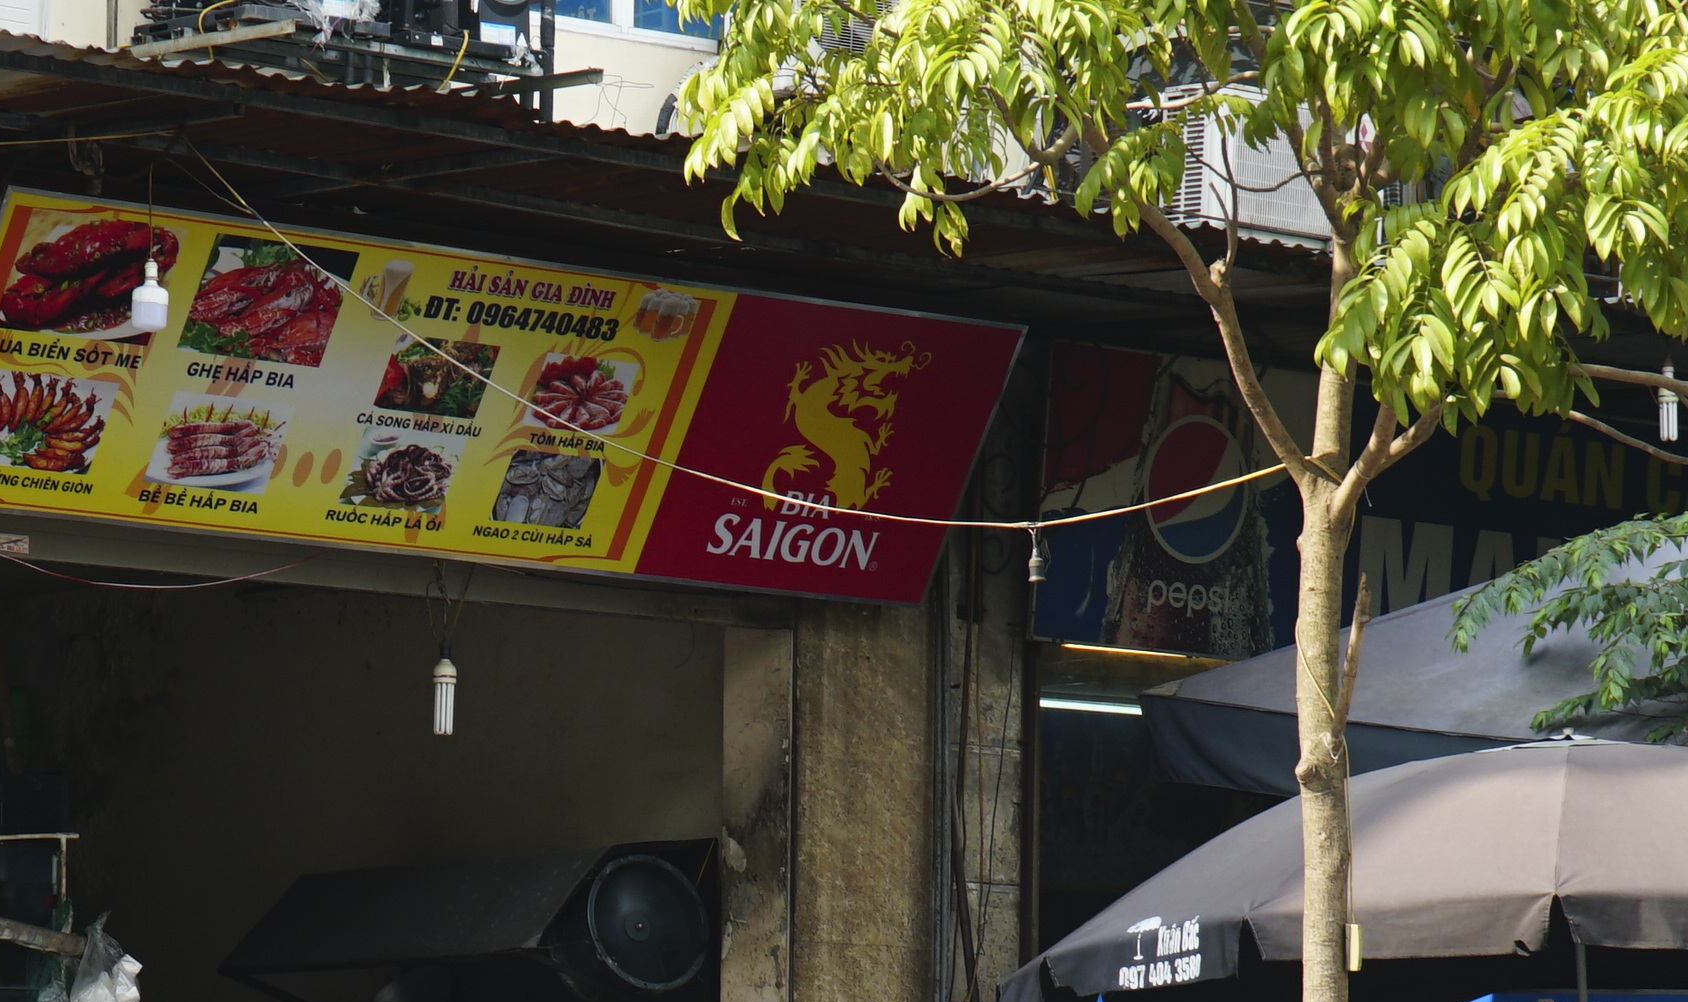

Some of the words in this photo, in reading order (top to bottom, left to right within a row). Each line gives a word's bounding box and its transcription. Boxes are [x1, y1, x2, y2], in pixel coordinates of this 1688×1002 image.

[449, 266, 486, 291] HẢI
[489, 270, 529, 298] SẢN
[531, 282, 564, 303] GIA
[566, 282, 616, 310] ĐÌNH
[424, 296, 461, 321] ĐT:
[467, 302, 620, 341] 0964740483
[27, 339, 70, 361] BIỂN
[74, 343, 113, 366] SỐT
[116, 353, 141, 370] ME
[186, 361, 222, 382] GHẸ
[225, 361, 262, 386] HẤP
[265, 371, 294, 389] BIA
[356, 412, 374, 426] CÁ
[376, 415, 411, 429] SONG
[412, 415, 440, 433] HẤP
[455, 417, 482, 437] DẦU
[529, 432, 556, 446] TÔM
[558, 434, 583, 450] HẤP
[585, 439, 605, 452] BIA
[1460, 422, 1626, 510] QUÁN
[21, 472, 58, 490] CHIÊN
[61, 477, 93, 494] GIÒN
[190, 491, 226, 510] HẤP
[230, 499, 258, 514] BIA
[780, 490, 830, 519] BIA
[325, 508, 368, 525] RUỐC
[371, 511, 403, 528] HẤP
[405, 514, 423, 530] LÁ
[473, 525, 510, 541] NGAO
[511, 530, 518, 540] 2
[545, 528, 573, 546] HẤP
[575, 532, 593, 548] SẢ
[706, 513, 880, 571] SAIGON
[1147, 578, 1230, 619] pepsi
[1148, 961, 1173, 986] 404
[1174, 953, 1201, 982] 3580
